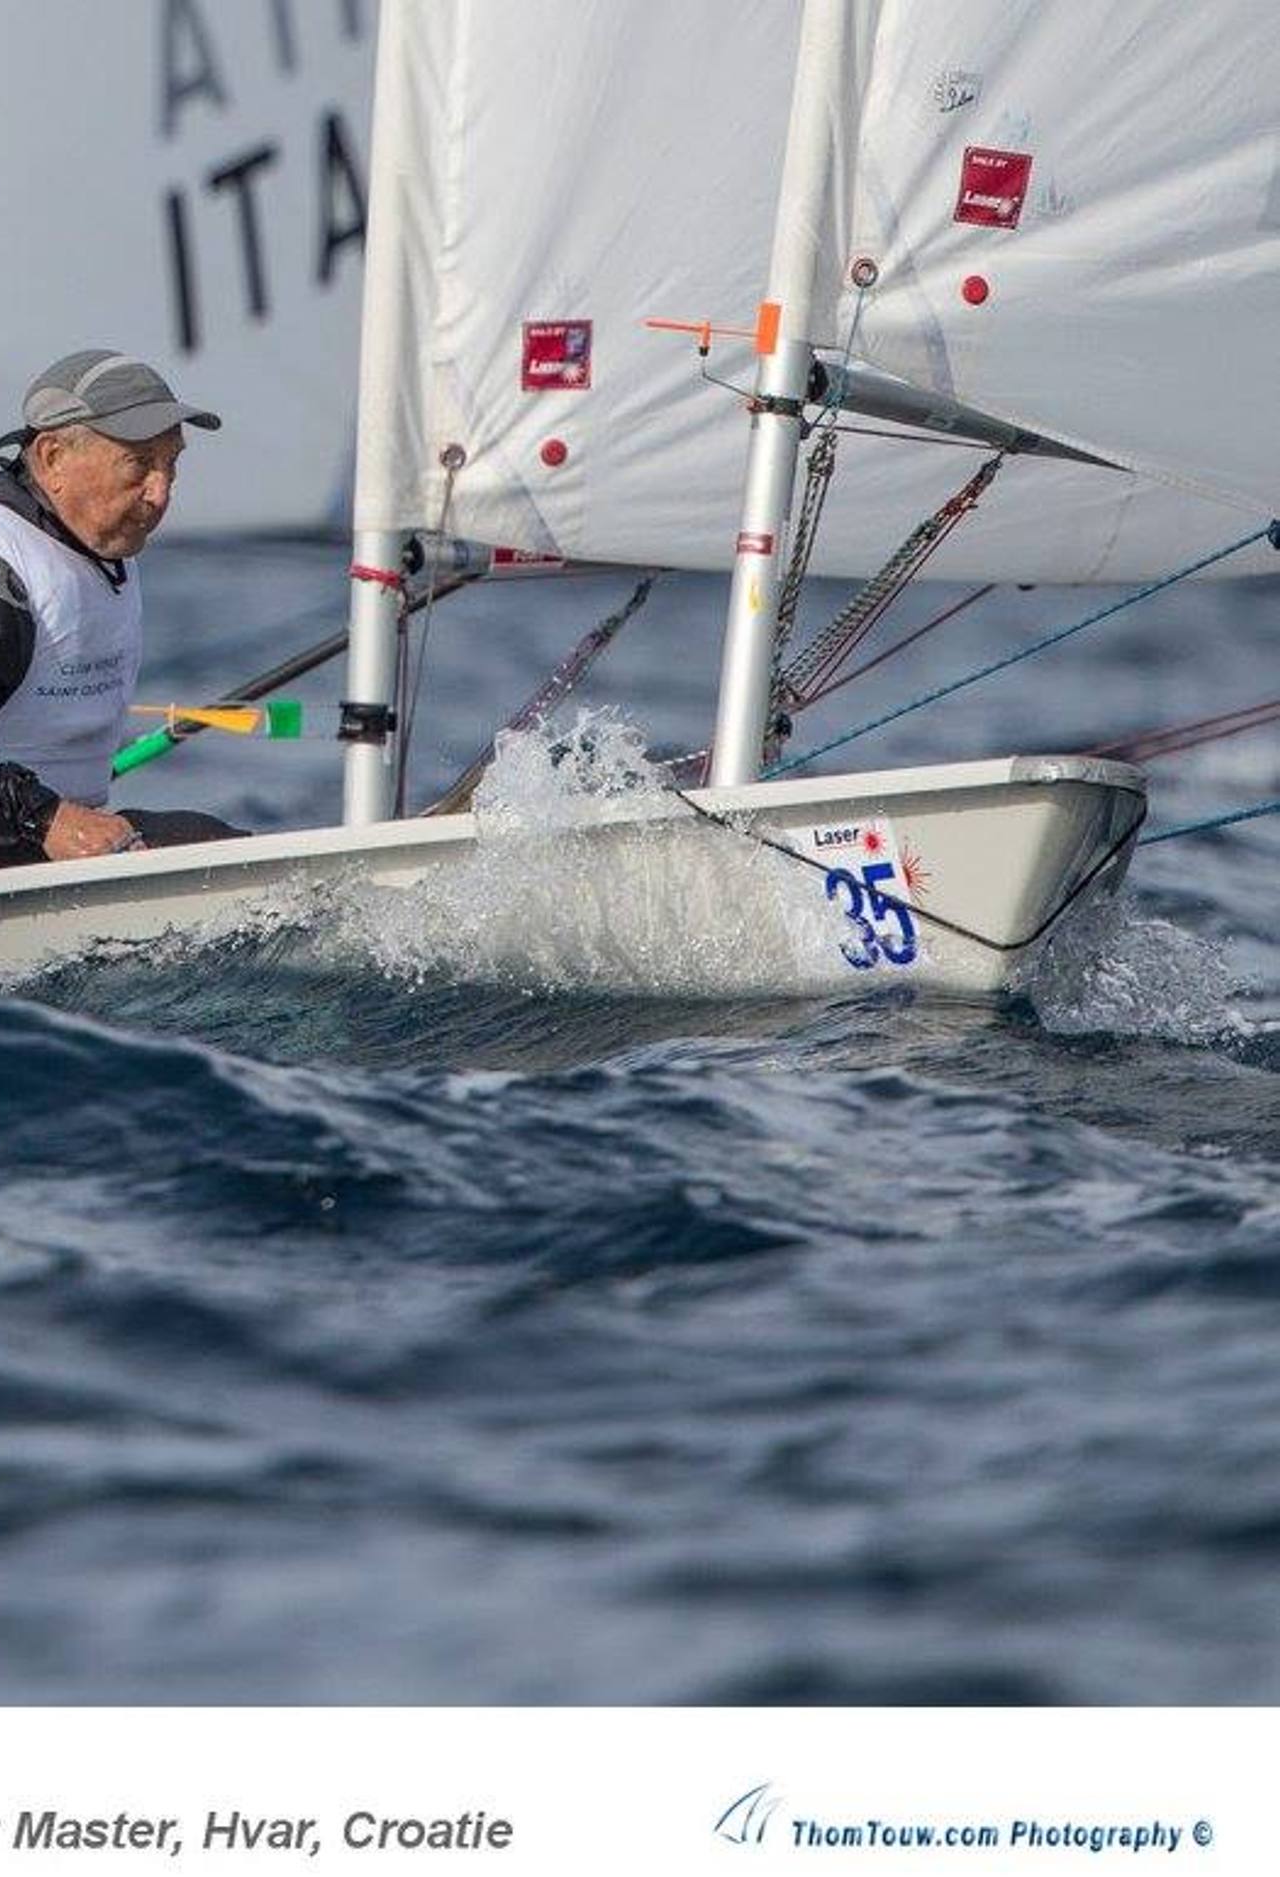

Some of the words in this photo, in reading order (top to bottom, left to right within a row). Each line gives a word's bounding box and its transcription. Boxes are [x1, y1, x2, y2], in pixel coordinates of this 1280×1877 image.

[164, 110, 369, 357] ITA
[813, 828, 860, 847] Laser
[825, 862, 917, 969] 35
